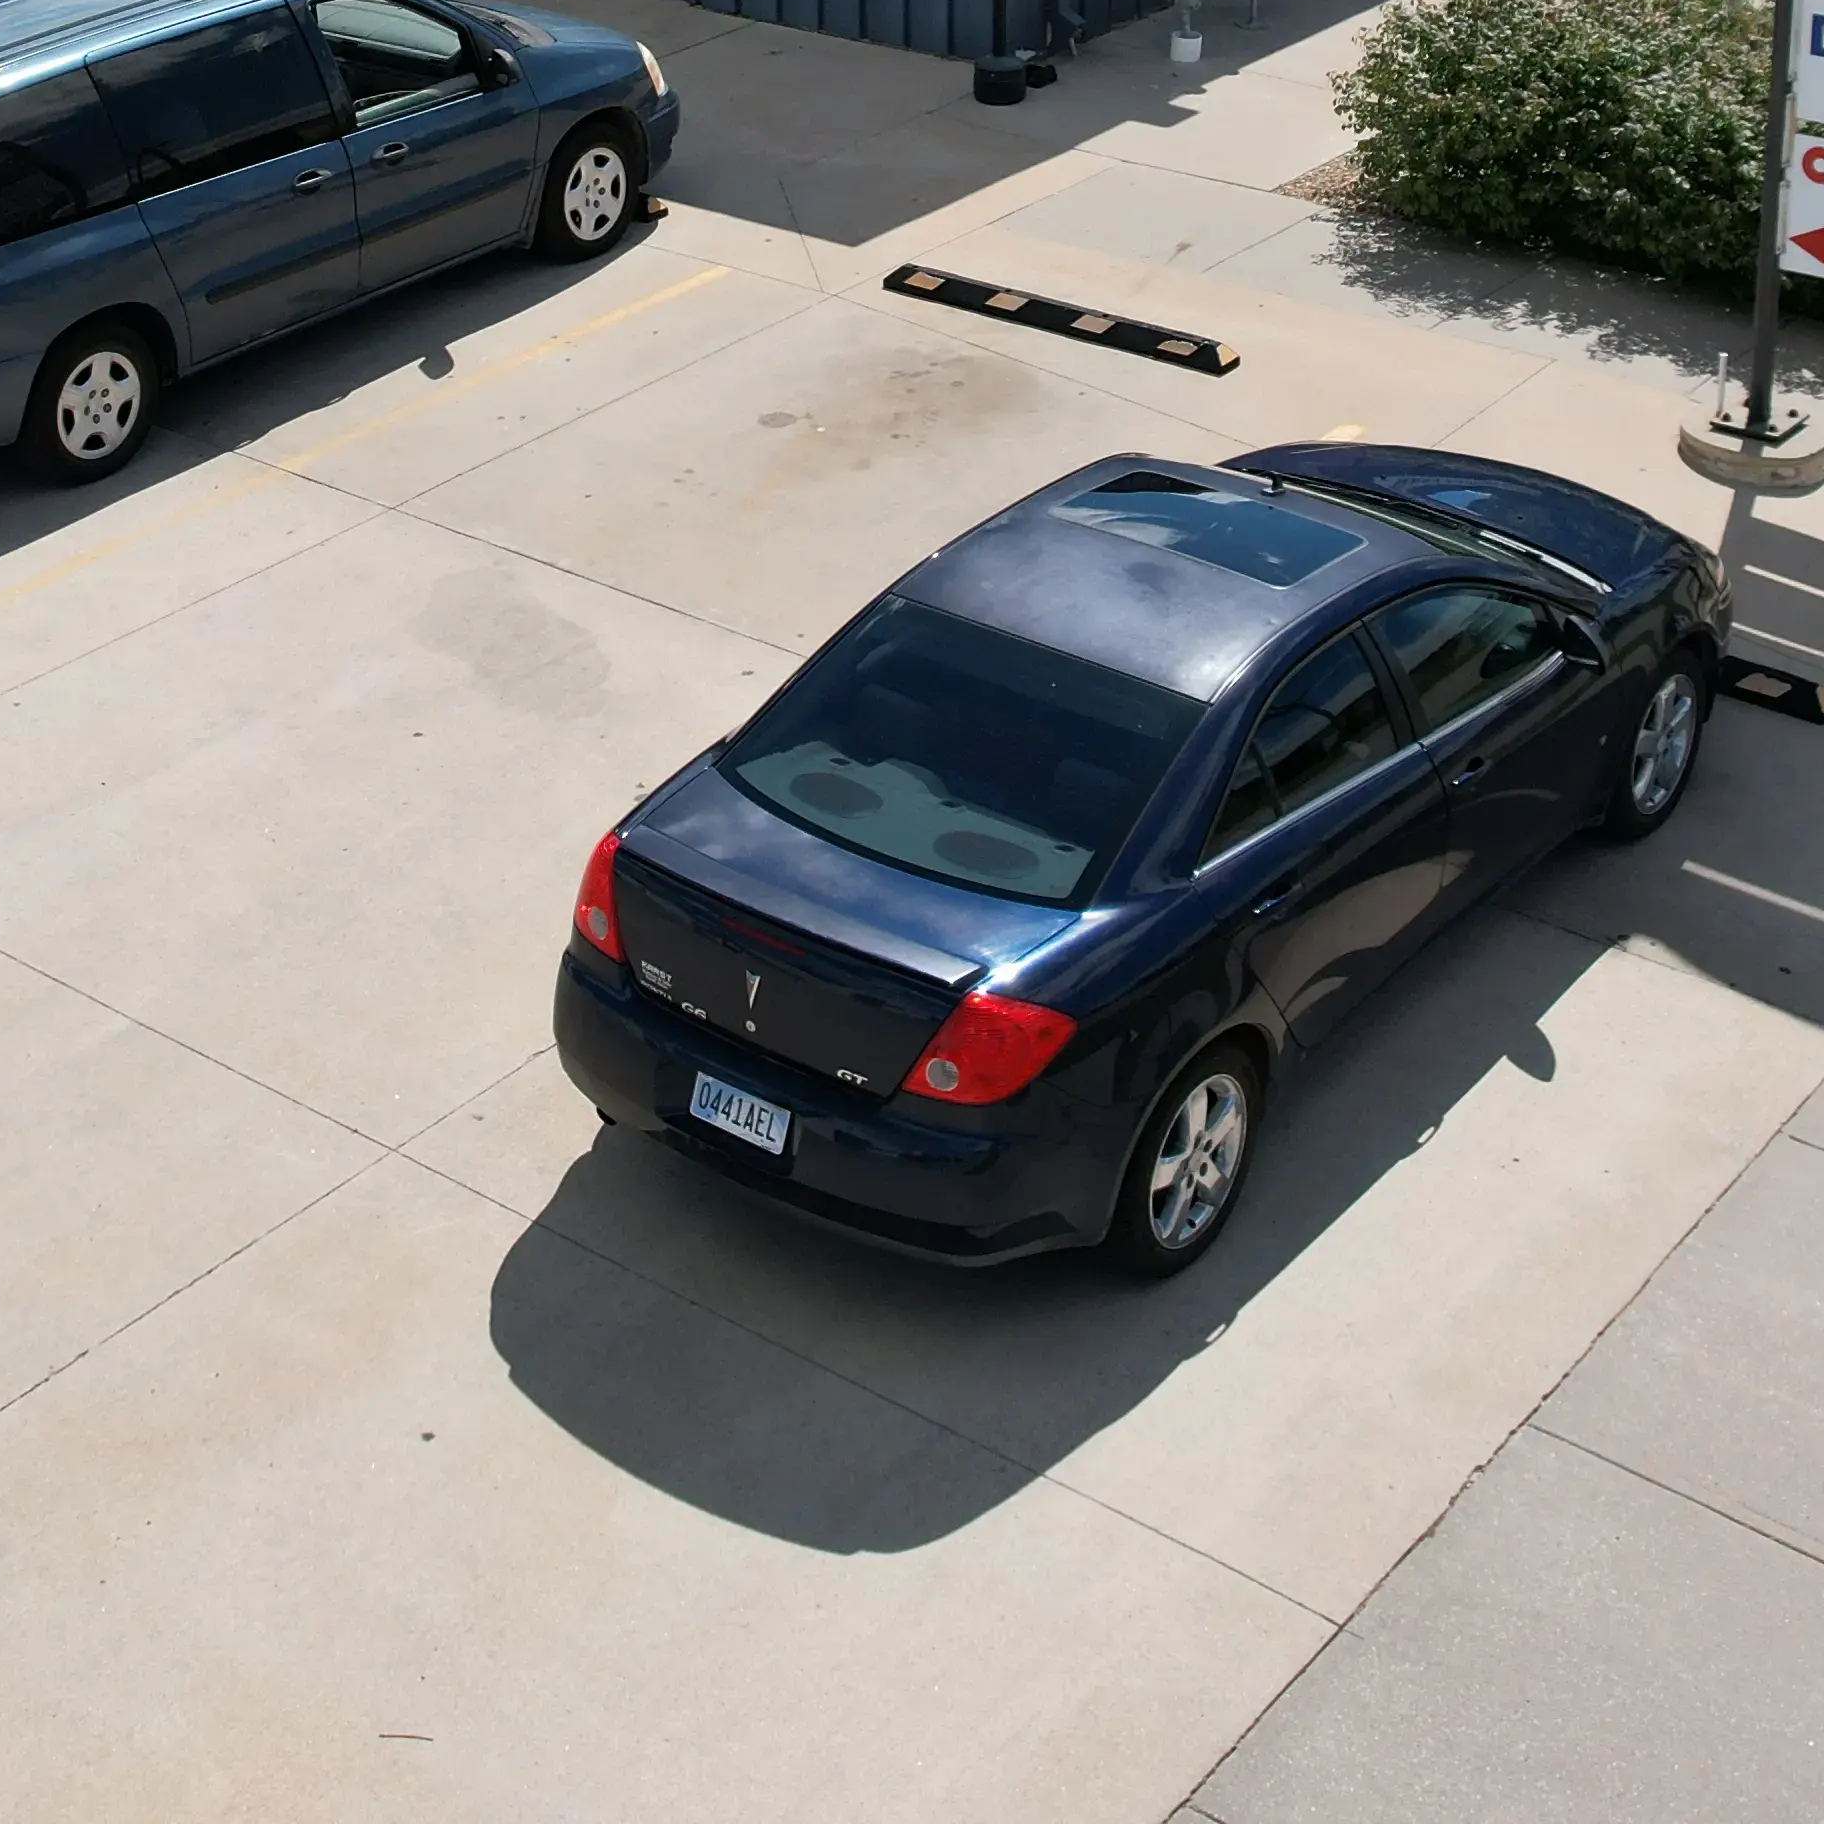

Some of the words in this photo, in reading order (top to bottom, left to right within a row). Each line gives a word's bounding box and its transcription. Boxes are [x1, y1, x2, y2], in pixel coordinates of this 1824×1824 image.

[681, 1001, 707, 1020] G6
[836, 1069, 869, 1085] GT
[699, 1081, 776, 1143] 0441AEL
